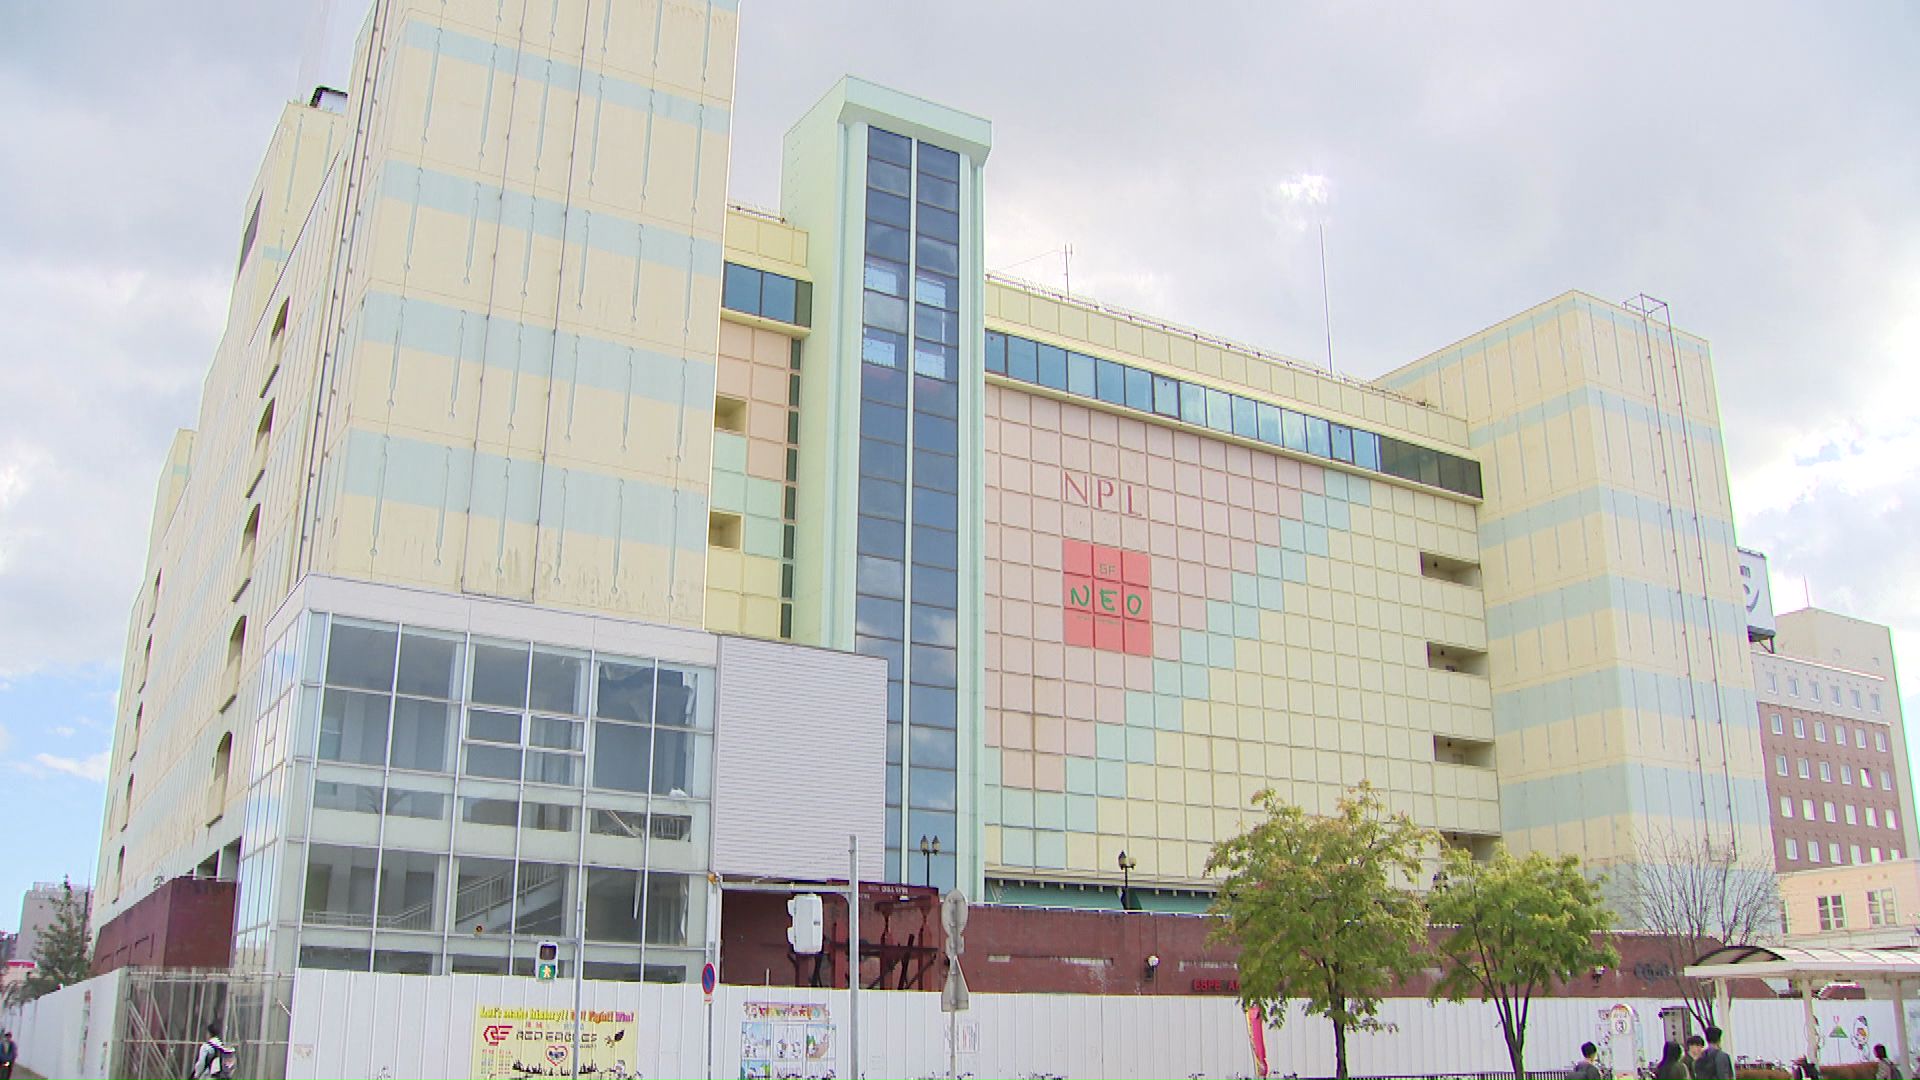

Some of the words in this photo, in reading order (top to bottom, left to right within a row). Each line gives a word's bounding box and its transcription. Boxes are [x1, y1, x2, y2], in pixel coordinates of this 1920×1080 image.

[1064, 471, 1142, 516] NPL
[1070, 585, 1142, 615] NEO
[516, 1030, 543, 1041] RED
